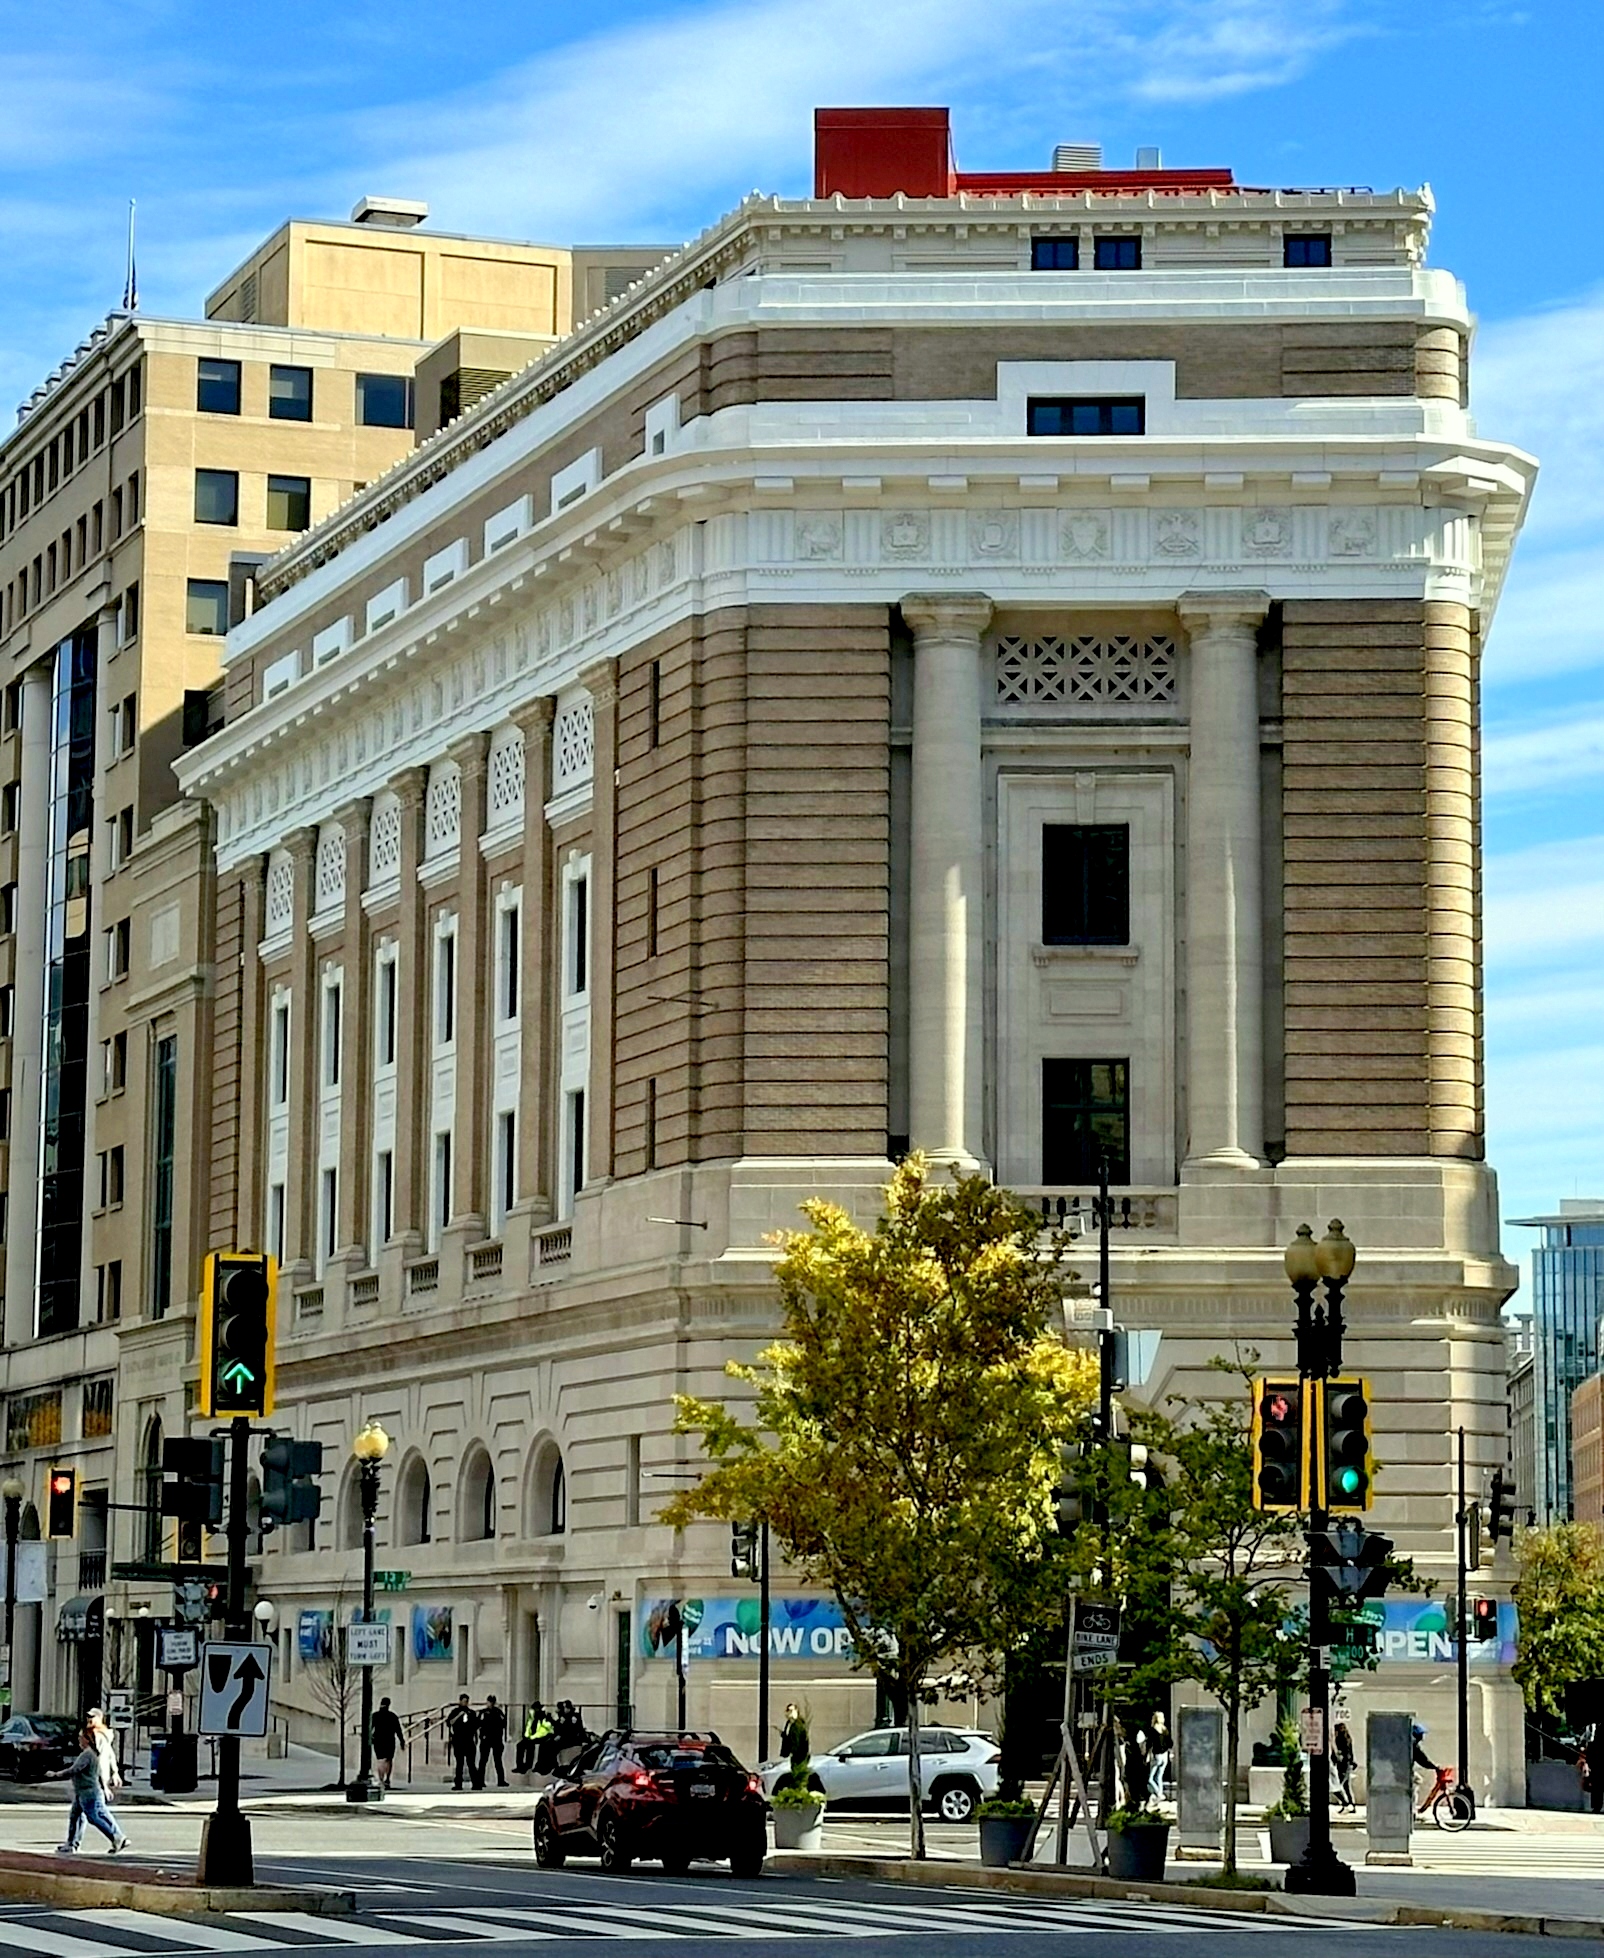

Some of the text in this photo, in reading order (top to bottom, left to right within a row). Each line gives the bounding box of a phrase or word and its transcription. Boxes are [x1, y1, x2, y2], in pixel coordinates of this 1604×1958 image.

[351, 1628, 385, 1636] LEFT LANE
[725, 1627, 805, 1655] NOW
[1076, 1632, 1117, 1644] BIKE LANE
[357, 1640, 378, 1648] MUST
[350, 1652, 366, 1660] TURN
[1081, 1653, 1109, 1667] ENDS
